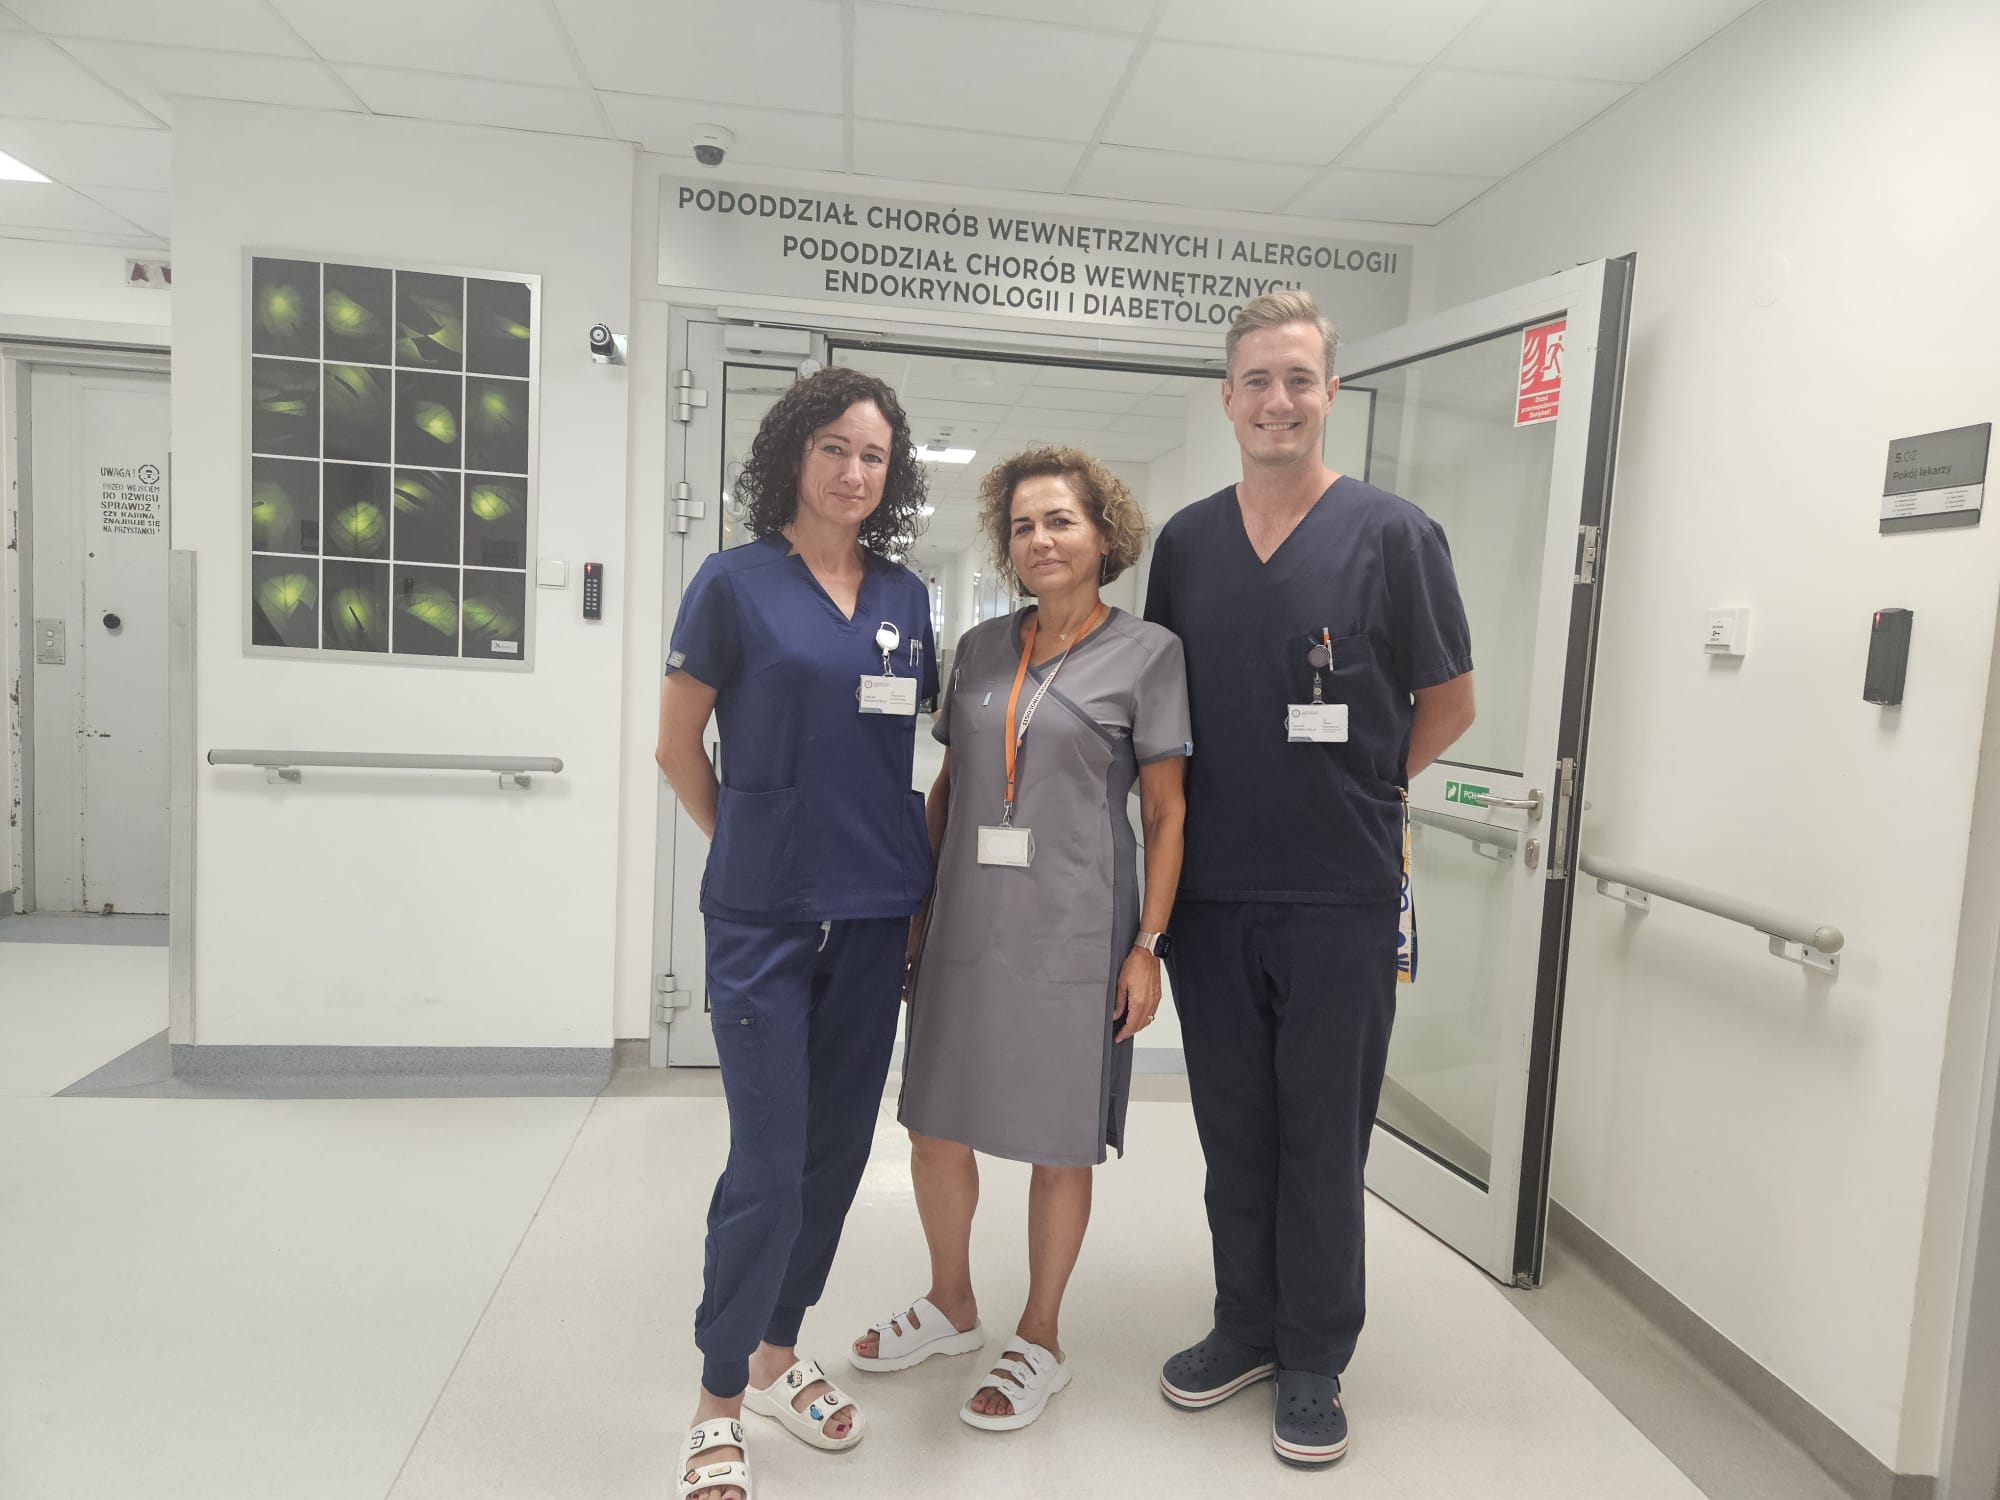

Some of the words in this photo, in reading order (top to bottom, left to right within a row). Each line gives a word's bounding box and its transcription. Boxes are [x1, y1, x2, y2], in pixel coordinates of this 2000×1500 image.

[679, 186, 858, 226] PODODDZIAŁ
[867, 206, 979, 238] CHORÓB
[988, 217, 1208, 259] WEWNĘTRZNYCH
[1216, 239, 1223, 260] I
[1231, 240, 1397, 274] ALERGOLOGII
[783, 235, 957, 273] PODODDZIAŁ
[966, 253, 1076, 284] CHORÓB
[825, 269, 1059, 312] ENDOKRYNOLOGII
[1069, 292, 1074, 313] I
[1893, 468, 1917, 480] Pokój
[1920, 465, 1952, 476] lekarzy
[103, 483, 124, 491] PRZED
[103, 491, 116, 500] DO
[103, 517, 146, 526] ZNAJDUJE
[103, 525, 112, 533] NA
